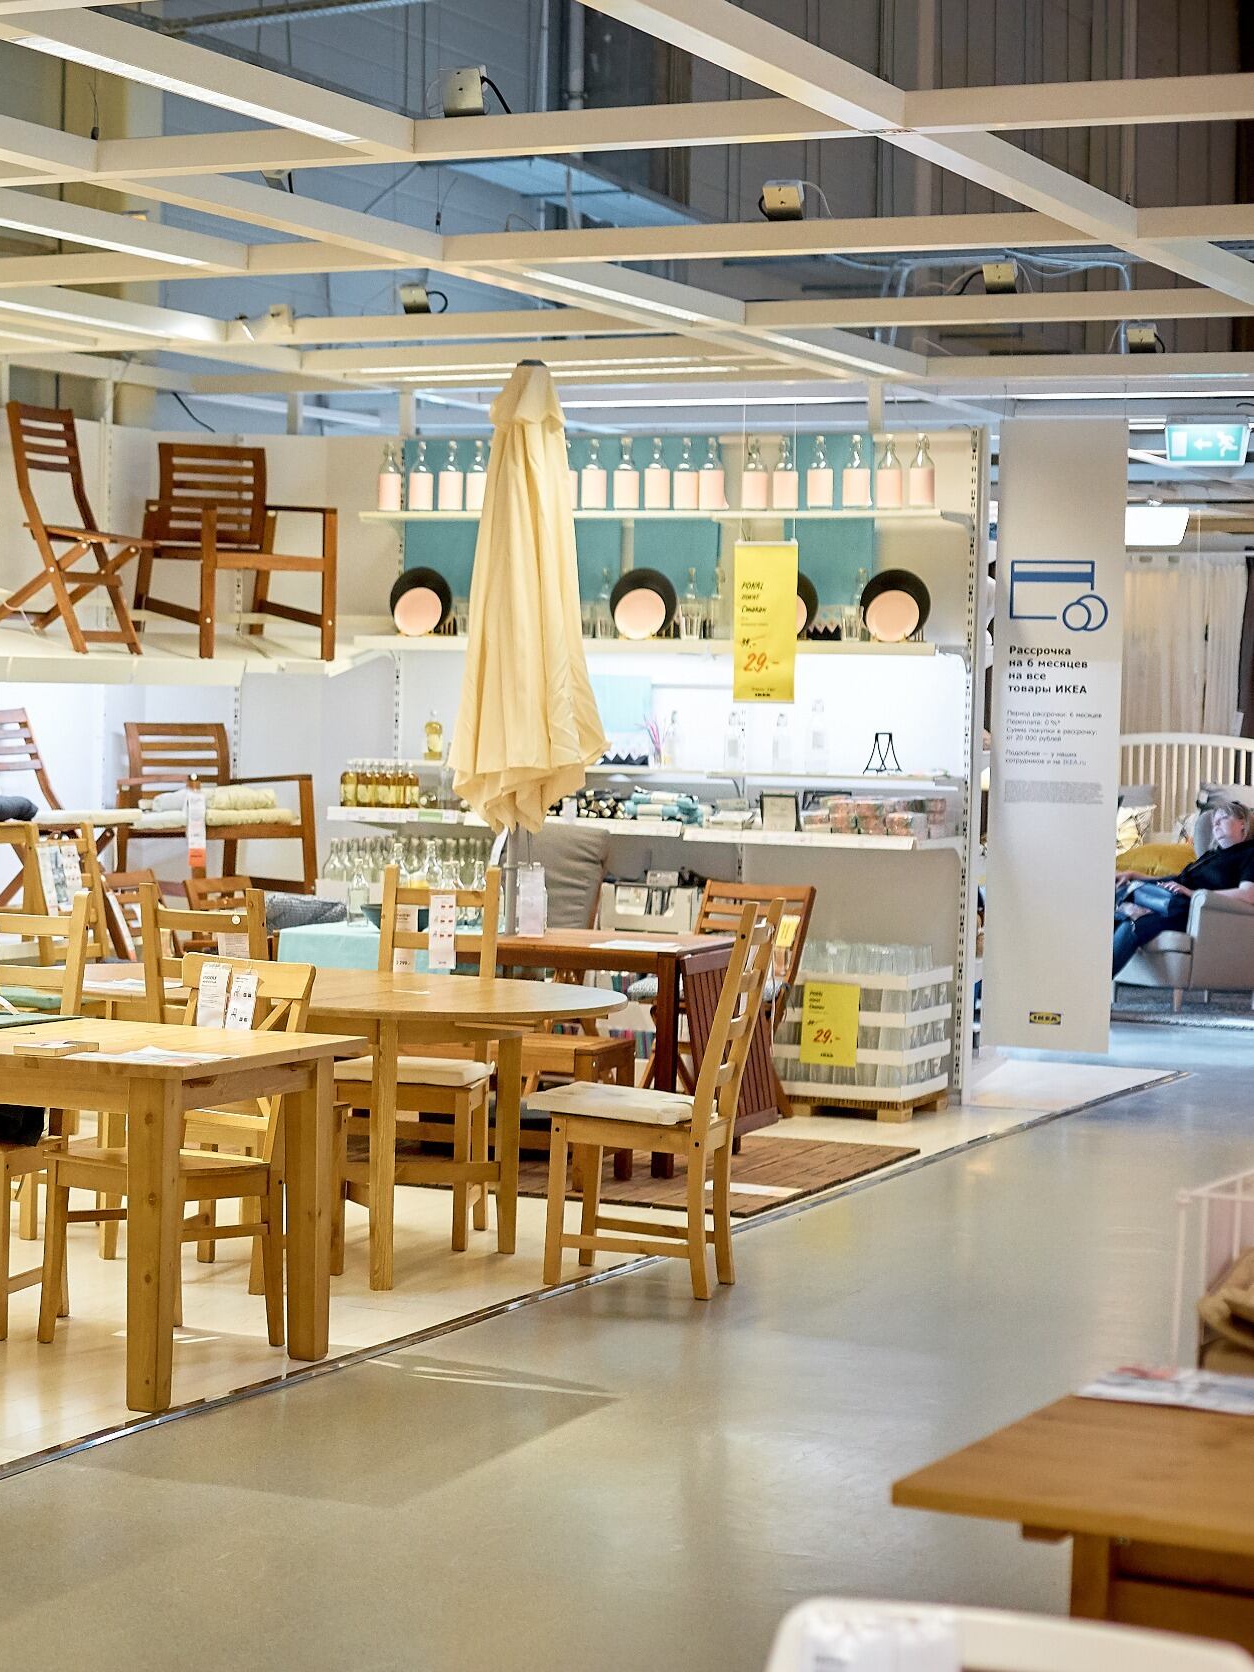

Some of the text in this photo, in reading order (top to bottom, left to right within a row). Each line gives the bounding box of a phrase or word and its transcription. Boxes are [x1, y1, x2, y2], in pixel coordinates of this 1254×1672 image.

[1009, 645, 1072, 656] Рассрочка
[743, 652, 779, 672] 29.-
[1009, 658, 1088, 669] на 6 месяцев
[1008, 672, 1047, 680] на все
[1008, 685, 1088, 694] товары ИКЕА
